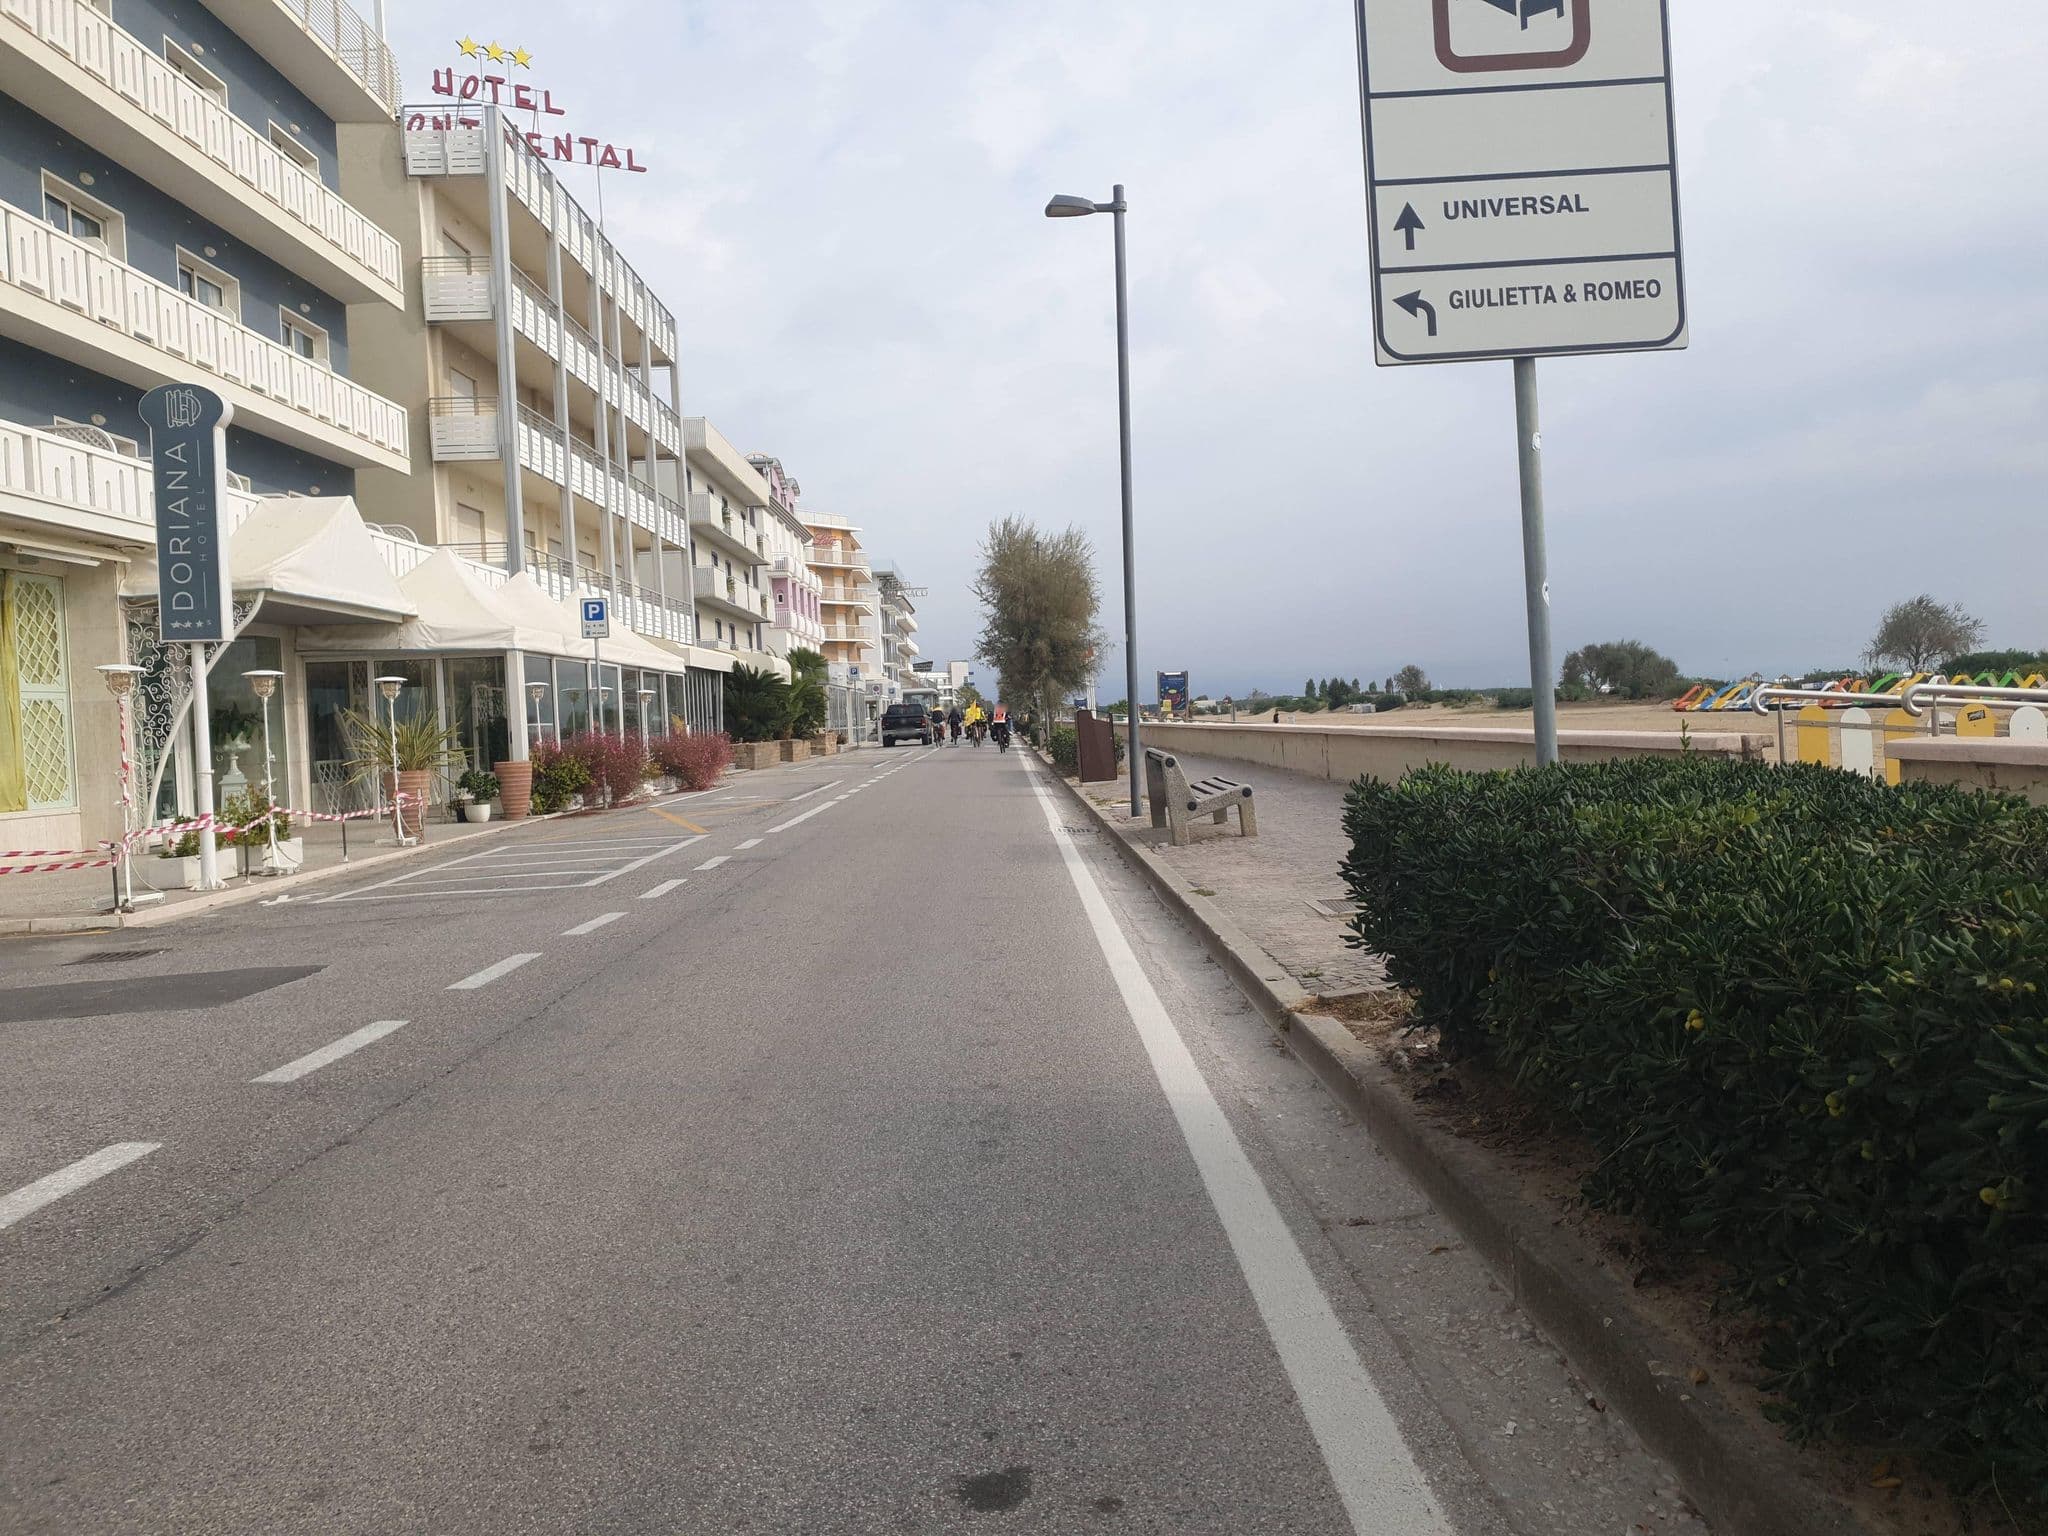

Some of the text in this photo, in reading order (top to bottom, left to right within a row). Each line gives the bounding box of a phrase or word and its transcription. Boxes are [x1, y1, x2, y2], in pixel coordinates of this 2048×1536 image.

[432, 67, 565, 115] HOTEL
[1443, 193, 1589, 220] UNIVERSAL
[1449, 278, 1662, 310] GIULIETTA & ROMEO
[164, 442, 195, 611] DORIANA
[196, 488, 209, 562] HOTEL
[588, 604, 600, 619] P
